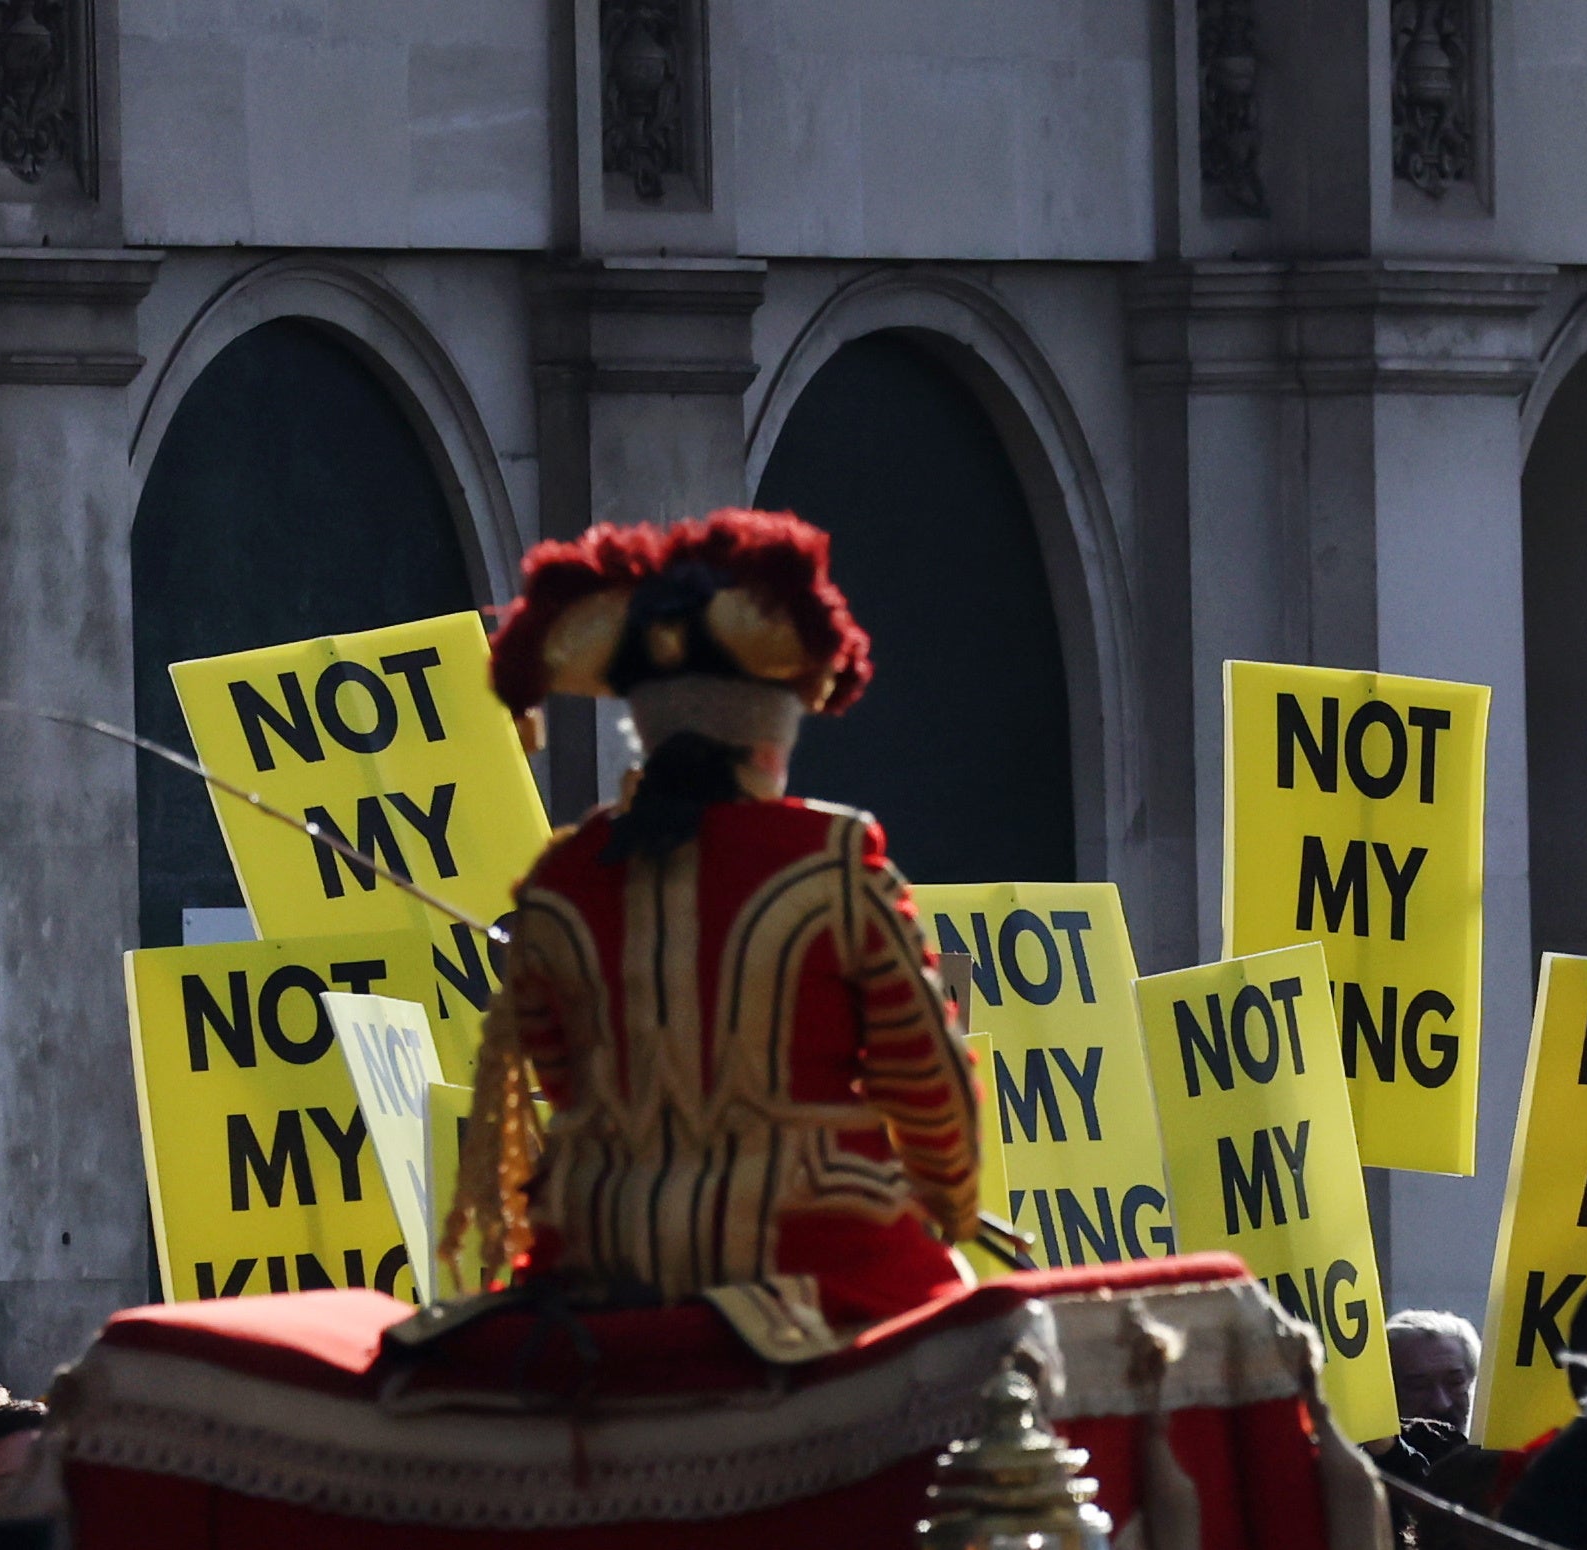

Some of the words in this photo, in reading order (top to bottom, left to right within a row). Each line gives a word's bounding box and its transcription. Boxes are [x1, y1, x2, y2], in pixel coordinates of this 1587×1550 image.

[228, 646, 446, 772] NOT
[1277, 693, 1451, 804] NOT
[303, 782, 458, 899] MY
[1296, 835, 1429, 941] MY
[934, 909, 1097, 1007] NOT
[181, 959, 386, 1071] NOT
[1173, 976, 1303, 1098] NOT
[1329, 981, 1459, 1089] NG
[993, 1047, 1103, 1144] MY
[226, 1106, 367, 1211] MY
[1217, 1119, 1310, 1235] MY
